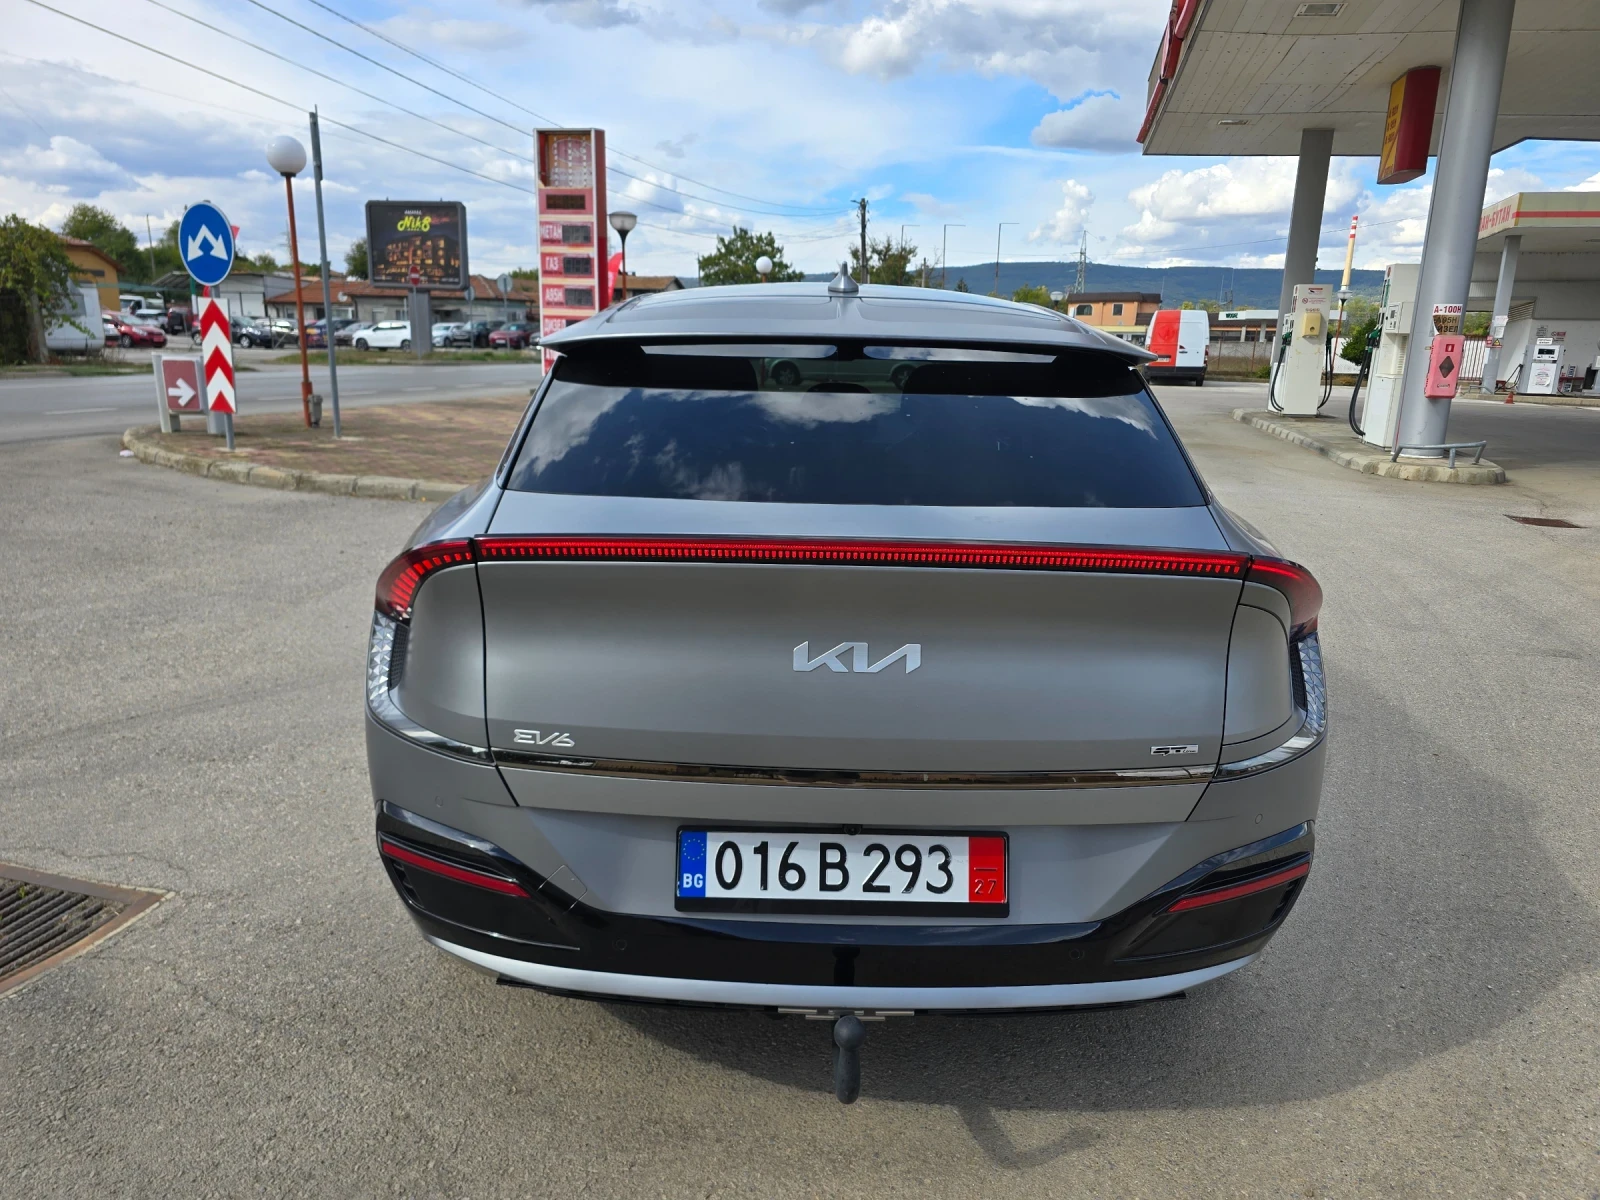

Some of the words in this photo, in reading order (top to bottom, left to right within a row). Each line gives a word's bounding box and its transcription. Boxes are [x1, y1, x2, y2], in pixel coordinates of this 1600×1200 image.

[793, 640, 921, 674] KIA
[513, 728, 575, 748] EV6
[682, 873, 704, 889] BG
[974, 878, 998, 895] 27
